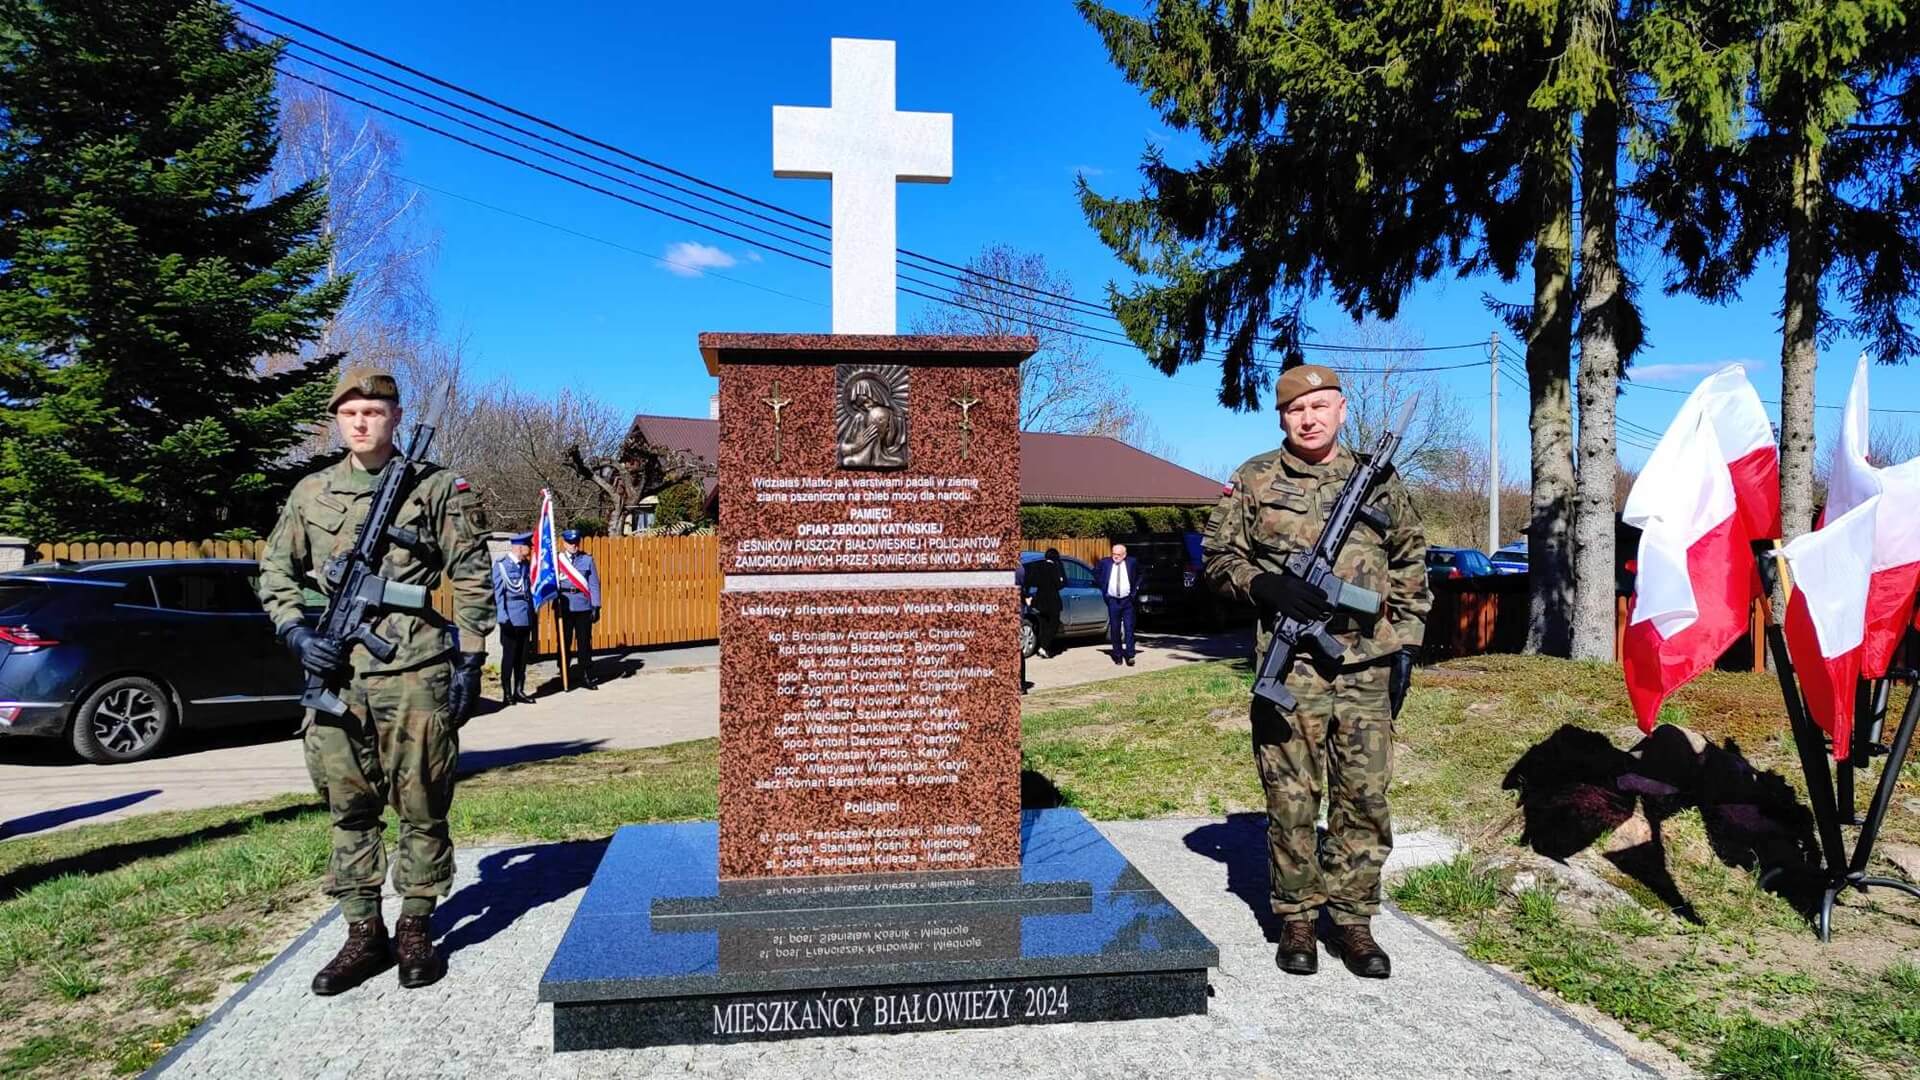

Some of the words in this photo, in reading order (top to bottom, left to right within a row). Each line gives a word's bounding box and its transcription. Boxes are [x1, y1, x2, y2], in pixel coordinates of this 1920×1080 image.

[752, 478, 800, 488] Widziałaś
[802, 478, 832, 488] Matko
[834, 478, 849, 489] jak
[852, 478, 903, 488] warstwami
[905, 478, 934, 488] padali
[948, 478, 979, 489] ziemię
[757, 492, 787, 502] ziarna
[790, 492, 845, 503] pszeniczne
[848, 492, 861, 501] na
[863, 490, 889, 501] chleb
[892, 492, 917, 502] mocy
[920, 490, 935, 500] dla
[938, 490, 973, 500] narodu.
[850, 508, 892, 521] PAMIĘCI
[798, 524, 830, 536] OFIAR
[832, 523, 879, 535] ZBRODNI
[881, 520, 944, 534] KATYŃSKIEJ
[738, 538, 793, 551] LEŚNIKÓW
[795, 539, 843, 551] PUSZCZY
[845, 538, 921, 550] BIAŁOWIESKIEJ
[929, 535, 1000, 549] POLICJANTÓW
[735, 555, 834, 567] ZAMORDOWANYCH
[836, 555, 869, 565] PRZEZ
[871, 553, 928, 565] SOWIECKIE
[930, 553, 961, 564] NKWD
[963, 553, 973, 563] W
[795, 605, 854, 615] oficerowie
[857, 604, 899, 615] rezerwy
[903, 603, 943, 615] Wojska
[946, 602, 1000, 614] Polskiego
[844, 800, 900, 814] Policjanci
[713, 990, 866, 1036] MIESZKAŃCY
[874, 983, 1015, 1026] BIAŁOWIEŻY
[1024, 985, 1070, 1018] 2024
